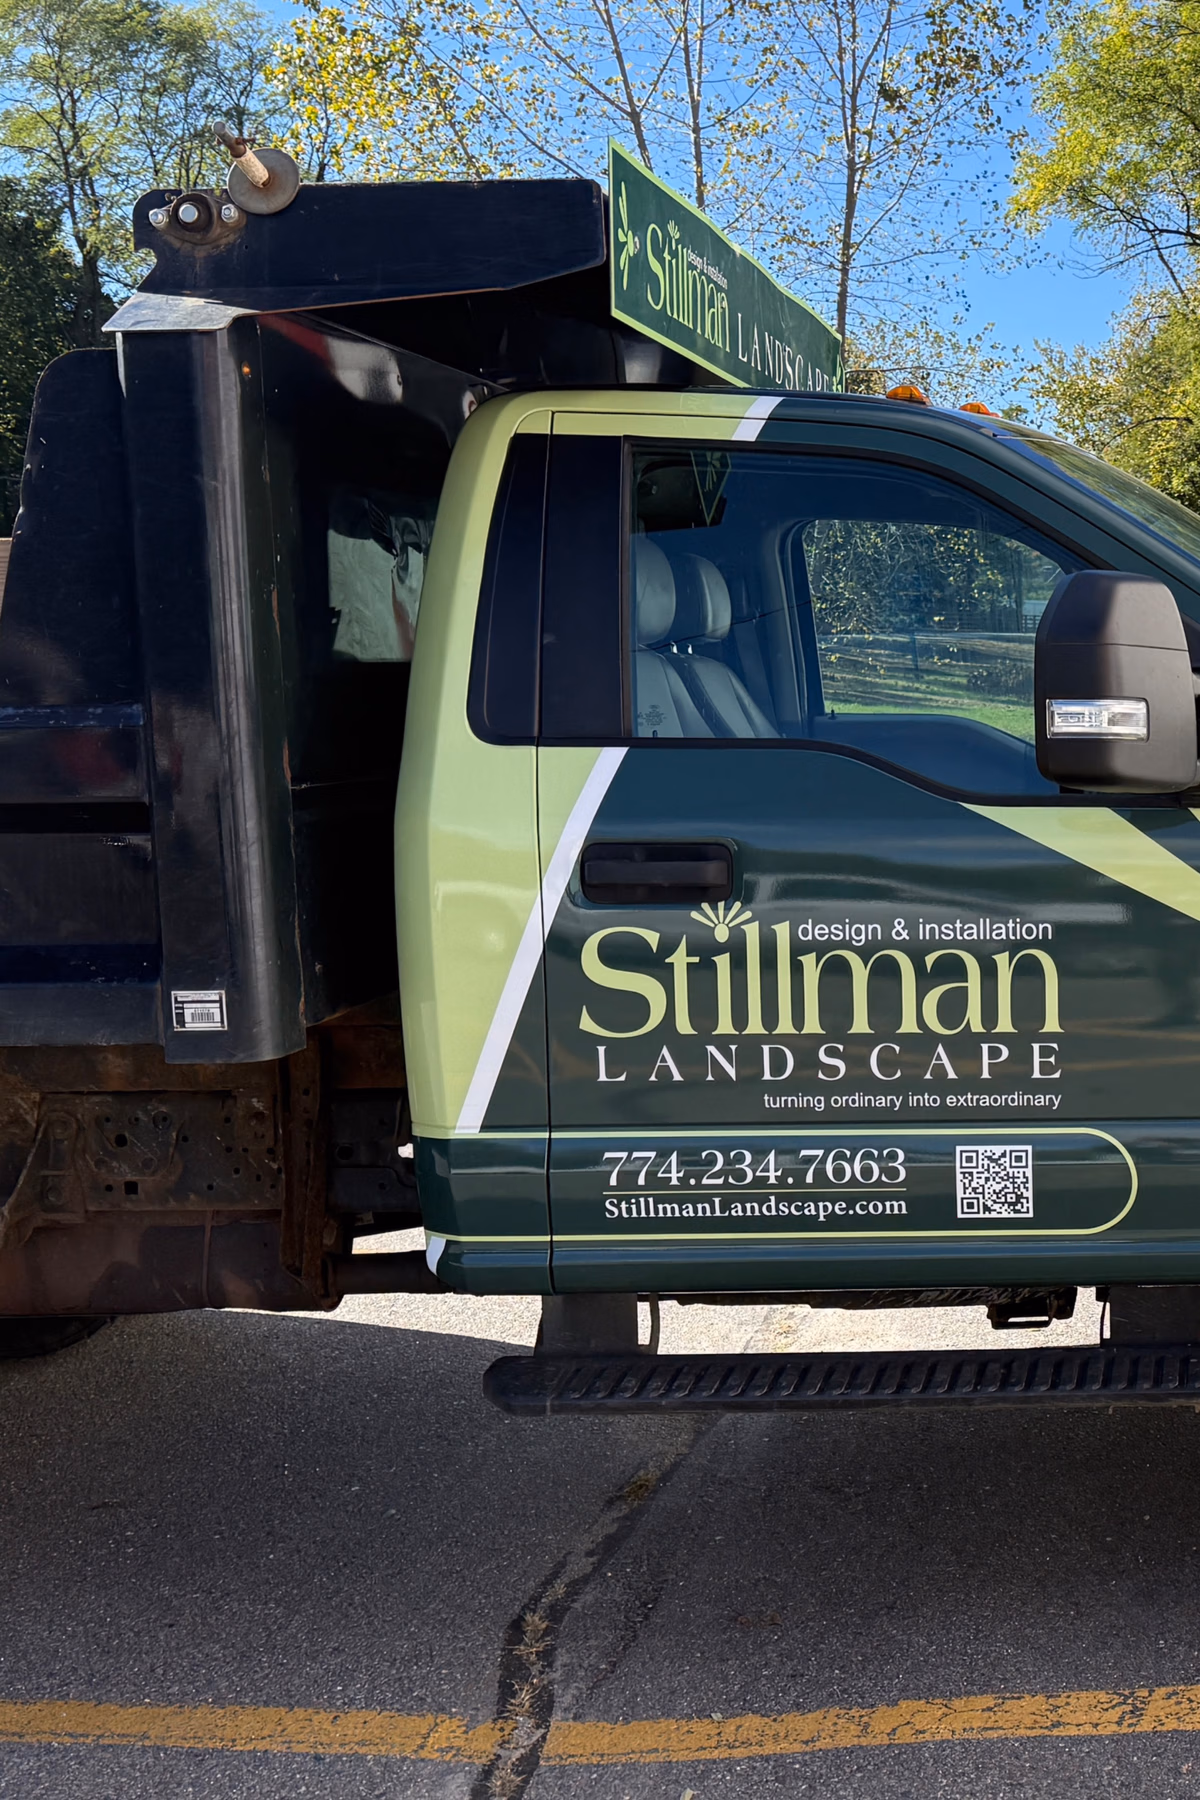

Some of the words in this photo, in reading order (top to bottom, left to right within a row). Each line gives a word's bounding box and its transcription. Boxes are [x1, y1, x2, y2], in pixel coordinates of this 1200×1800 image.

[646, 221, 731, 353] Stillman
[798, 918, 882, 946] design
[891, 918, 910, 941] &
[918, 917, 1052, 941] installation
[579, 918, 1065, 1039] Stillman
[597, 1043, 1063, 1083] LANDSCAPE
[763, 1093, 825, 1111] turning
[830, 1092, 902, 1111] ordinary
[908, 1092, 940, 1108] into
[946, 1091, 1062, 1110] extraordinary
[602, 1147, 907, 1187] 774.234.7663
[604, 1196, 908, 1222] StillmanLandscape.com
